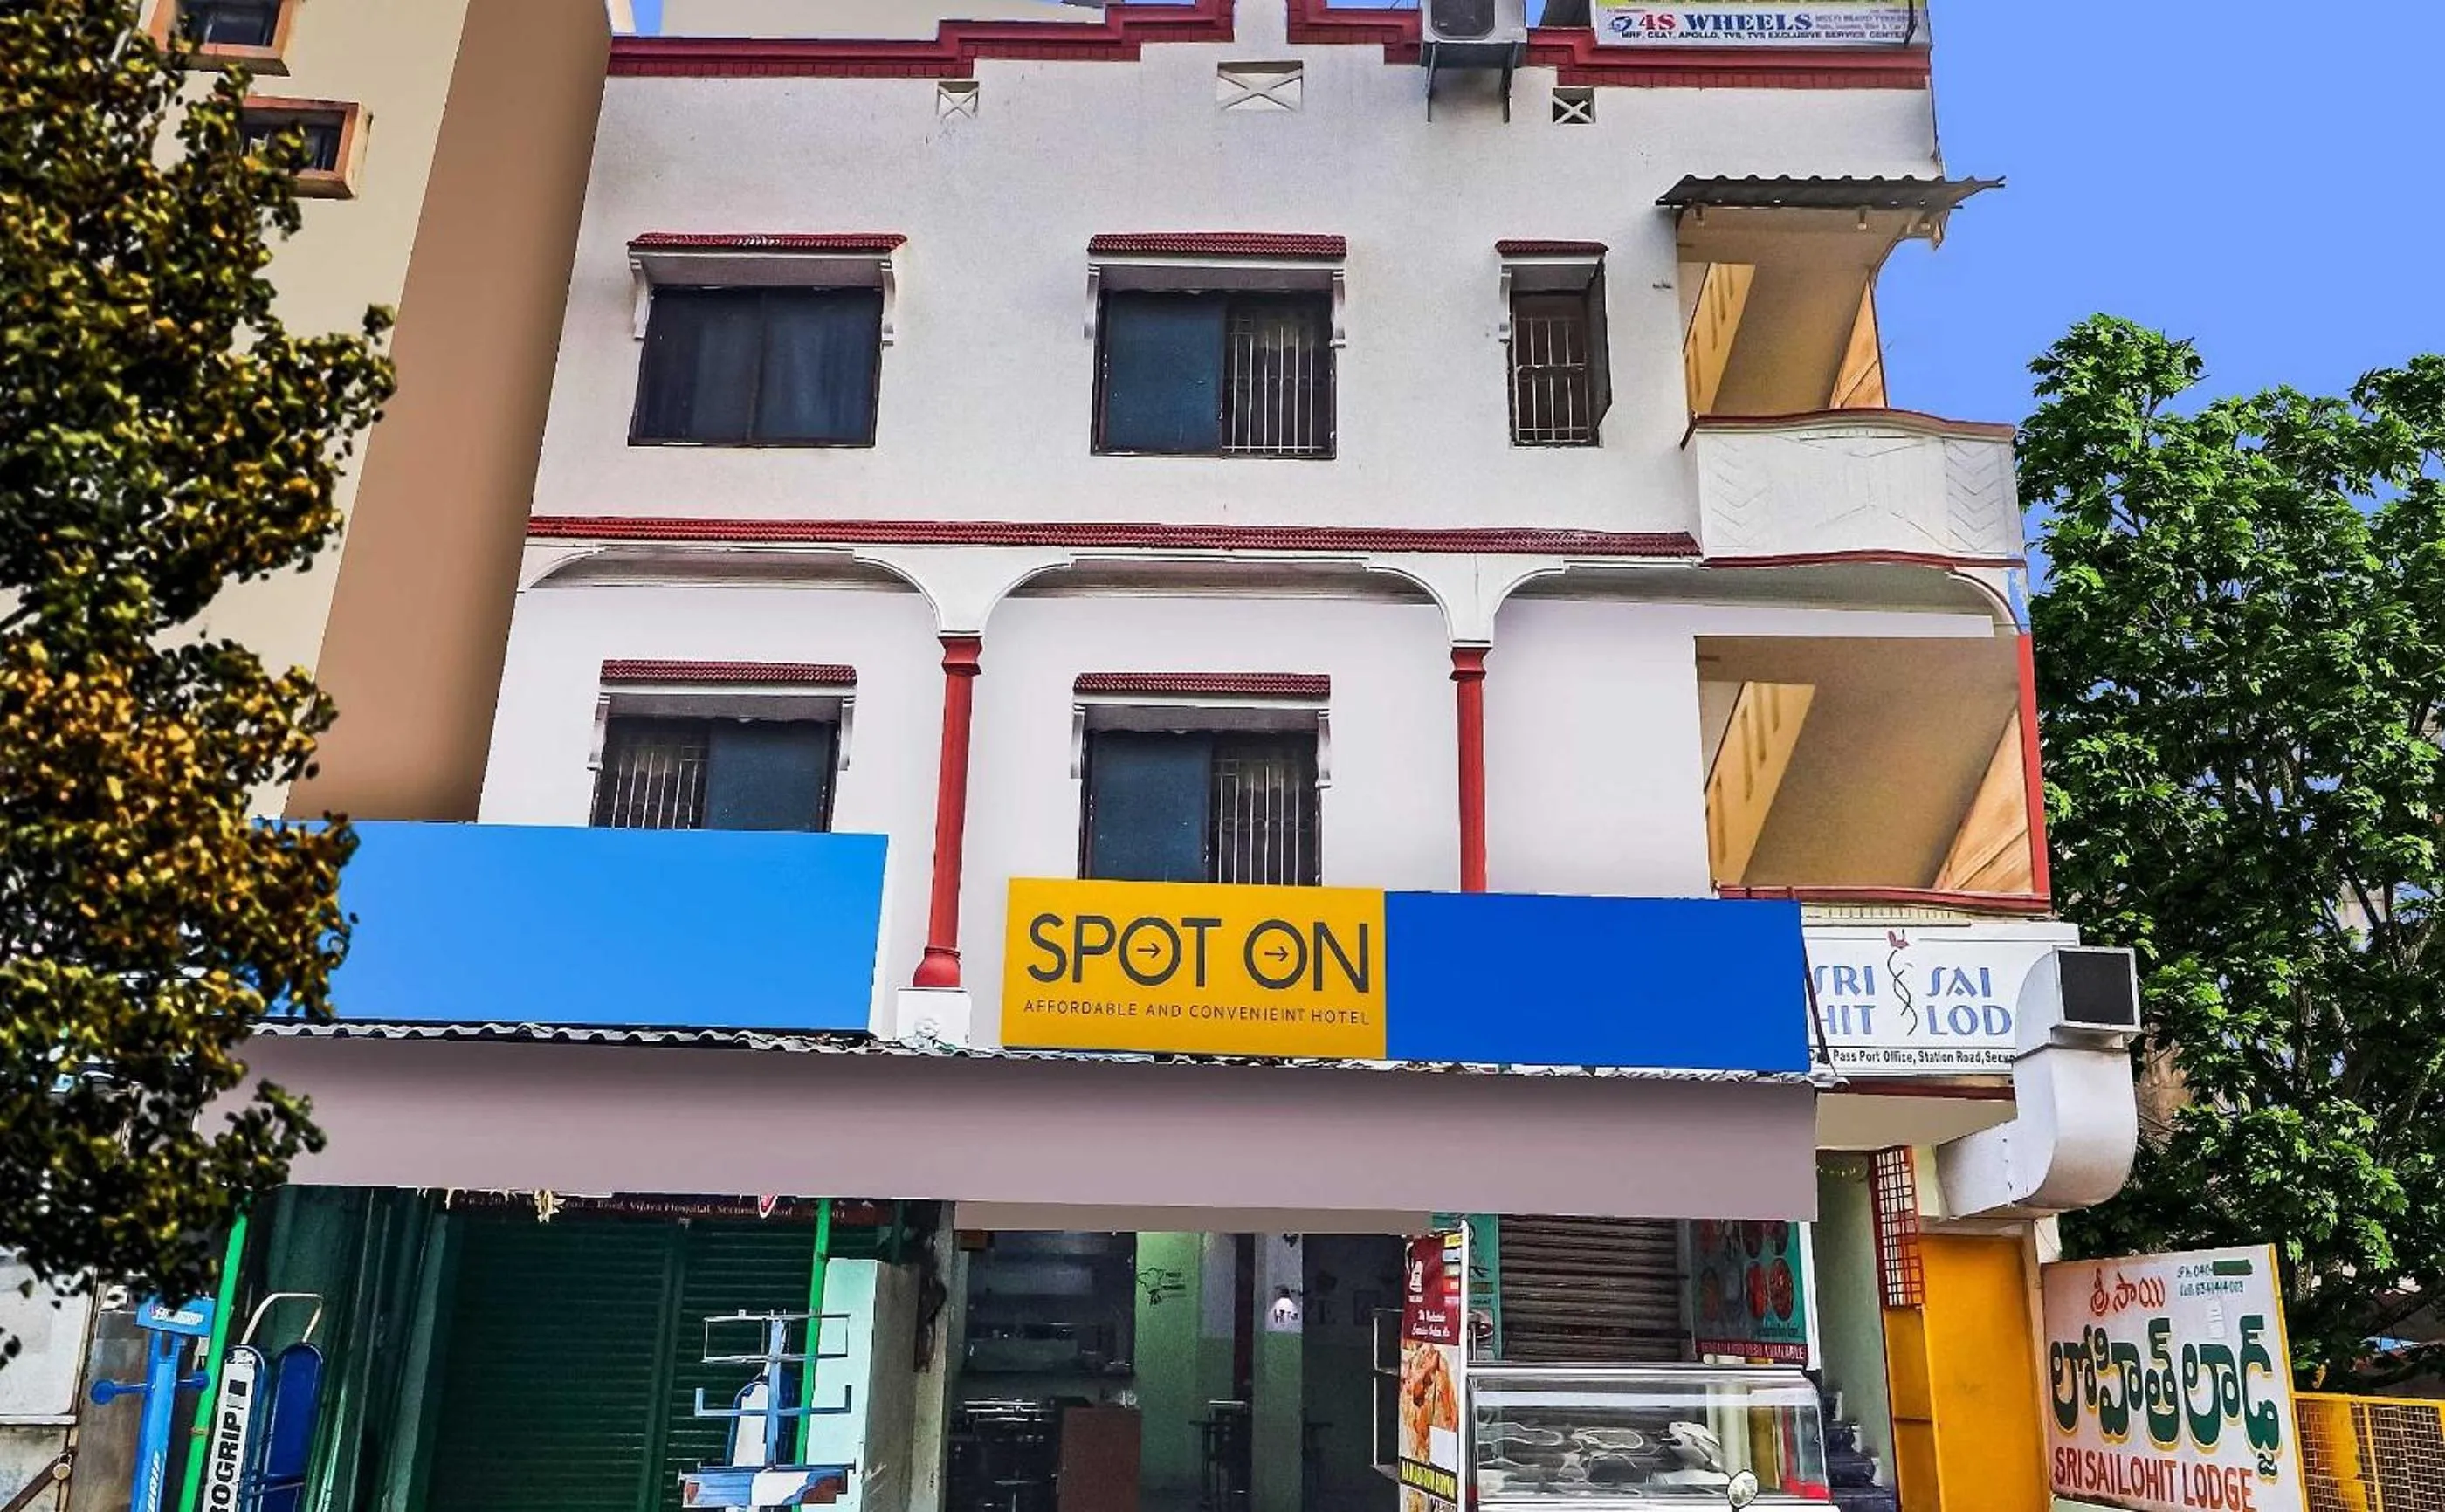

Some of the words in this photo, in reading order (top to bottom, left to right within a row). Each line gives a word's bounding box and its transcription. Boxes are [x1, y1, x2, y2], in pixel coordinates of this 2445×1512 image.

[1638, 14, 1676, 30] 4S
[1684, 14, 1813, 30] WHEELS
[1678, 31, 1720, 39] APOLLO,
[1768, 31, 1822, 39] EXCLUSIVE
[1825, 31, 1866, 39] SERVICE
[1027, 913, 1222, 987] SPOT
[1243, 918, 1369, 993] ON
[1926, 966, 1991, 997] SAI
[1023, 999, 1137, 1015] AFFORDABLE
[1145, 1004, 1181, 1017] AND
[1312, 1008, 1370, 1025] HOTEL
[1833, 1049, 1857, 1062] Pass
[1859, 1050, 1880, 1062] Port
[1918, 1050, 1953, 1063] Station
[2055, 1447, 2082, 1485] SRI
[2182, 1461, 2256, 1512] LODGE
